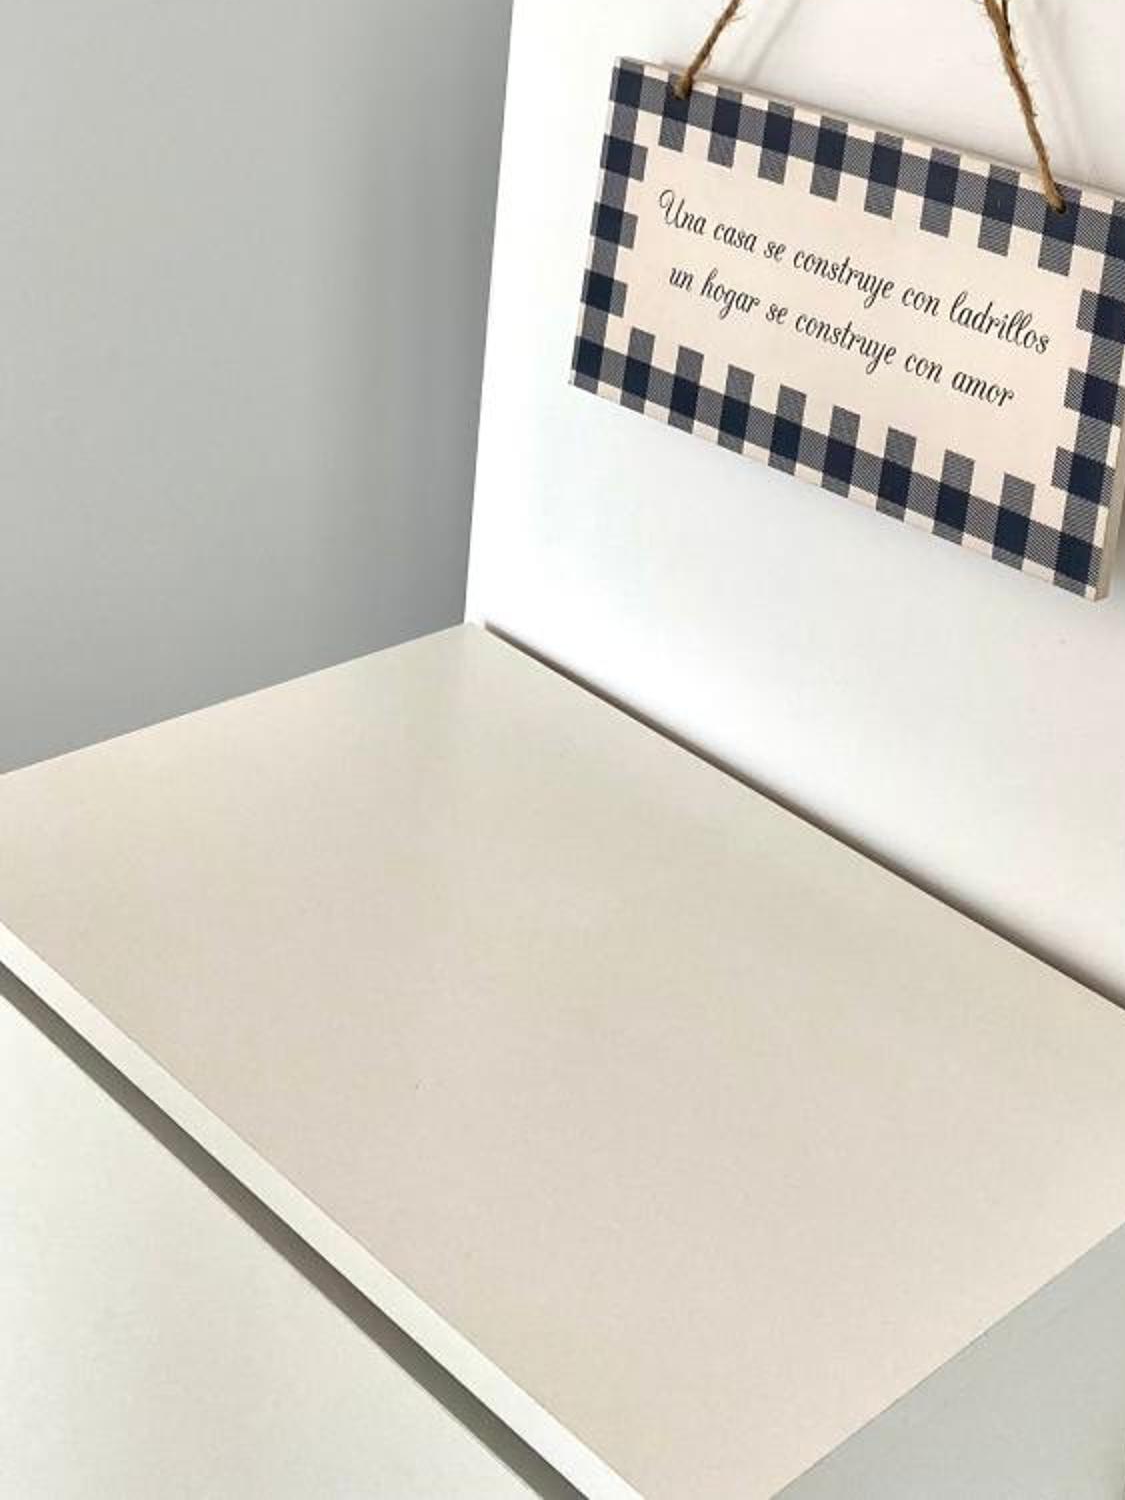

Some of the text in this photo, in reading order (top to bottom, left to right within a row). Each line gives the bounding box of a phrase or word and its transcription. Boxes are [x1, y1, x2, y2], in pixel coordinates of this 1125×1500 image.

[658, 189, 1050, 354] Una casa se construye con ladrillos
[669, 267, 1015, 407] un hogar se construye con amor
